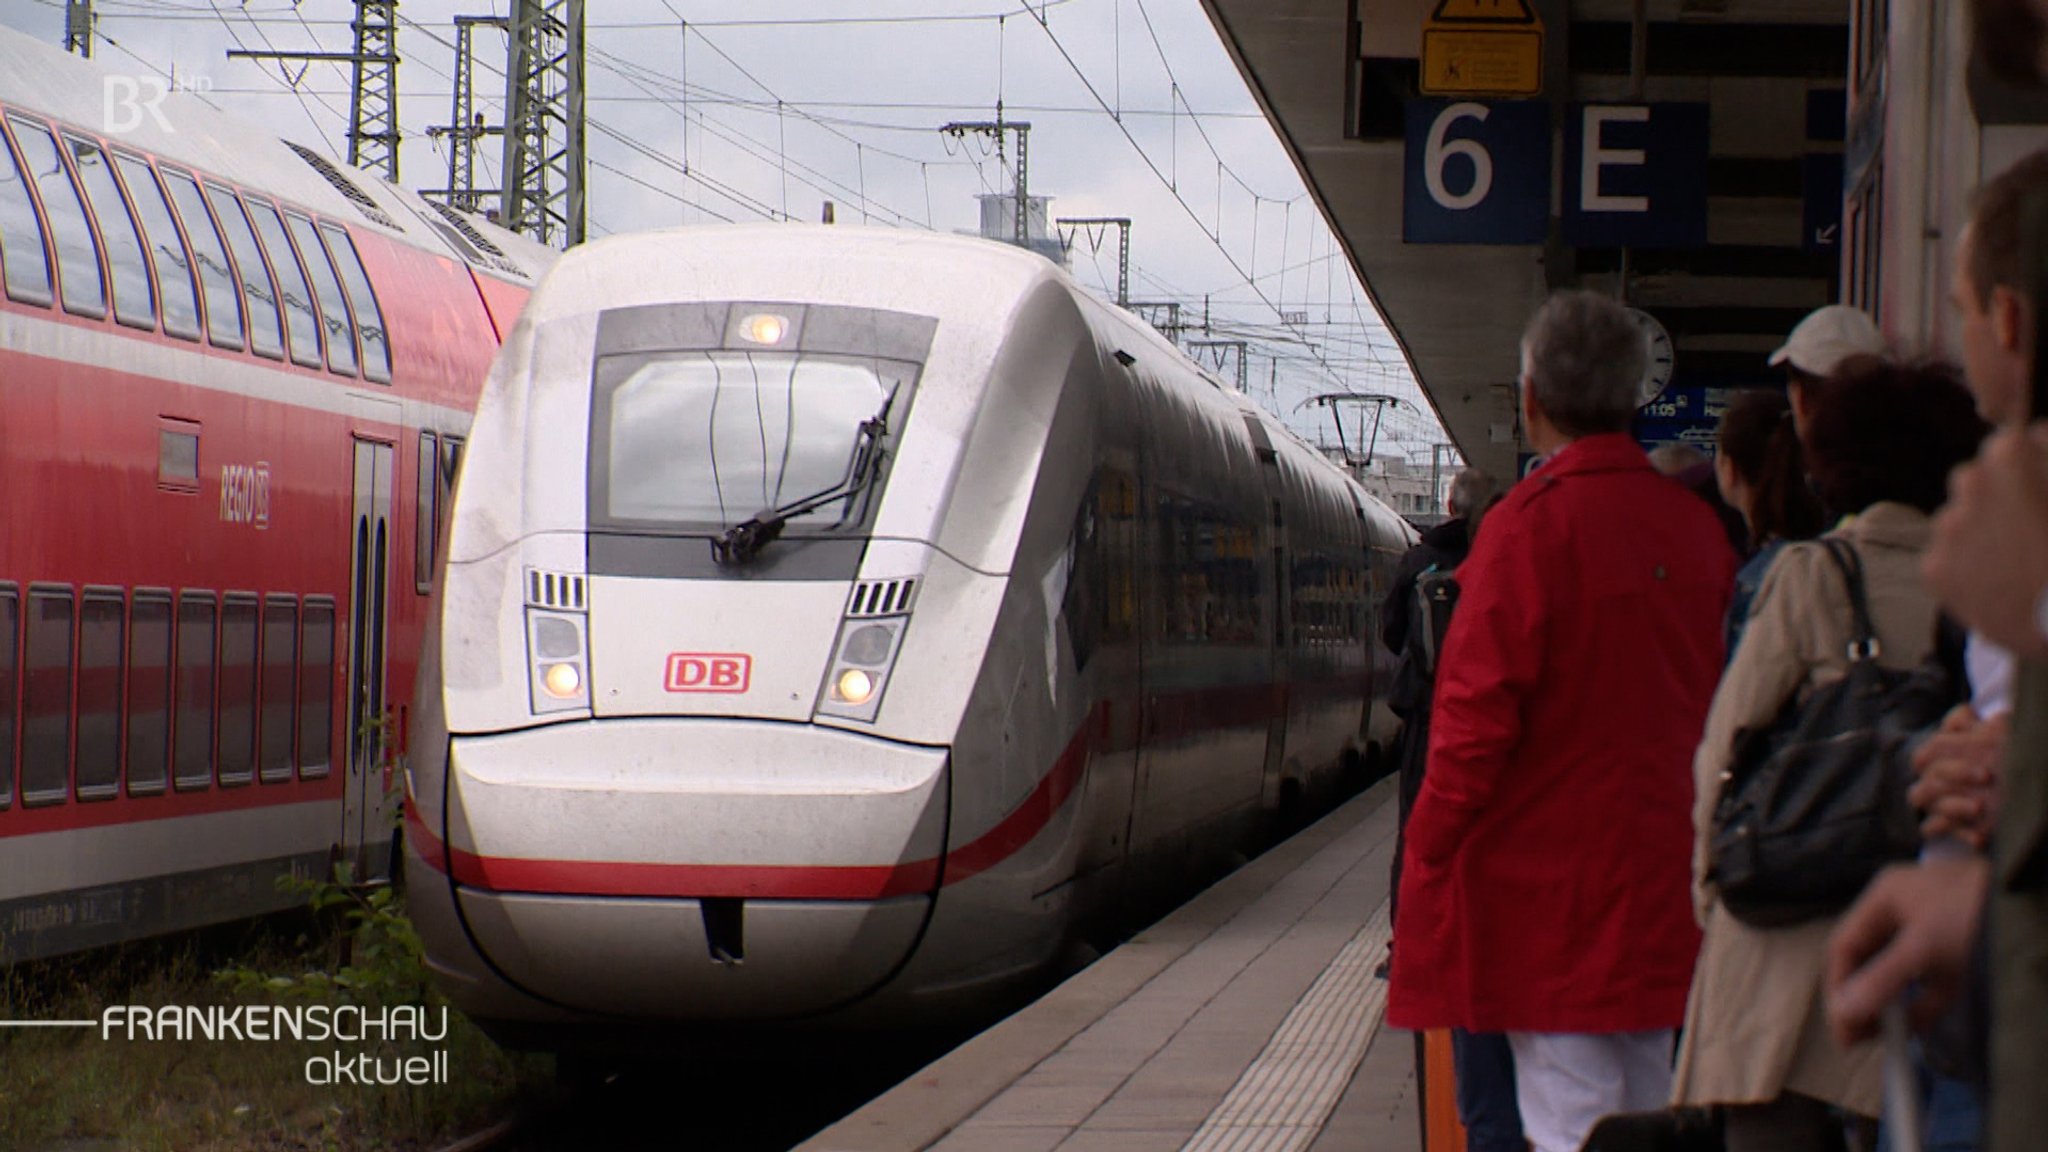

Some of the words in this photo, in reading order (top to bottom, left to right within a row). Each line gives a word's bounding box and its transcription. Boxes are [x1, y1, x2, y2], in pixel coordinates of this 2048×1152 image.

[1424, 103, 1493, 210] 6
[1580, 105, 1650, 212] E
[220, 465, 254, 522] REGIO
[675, 659, 740, 686] DB
